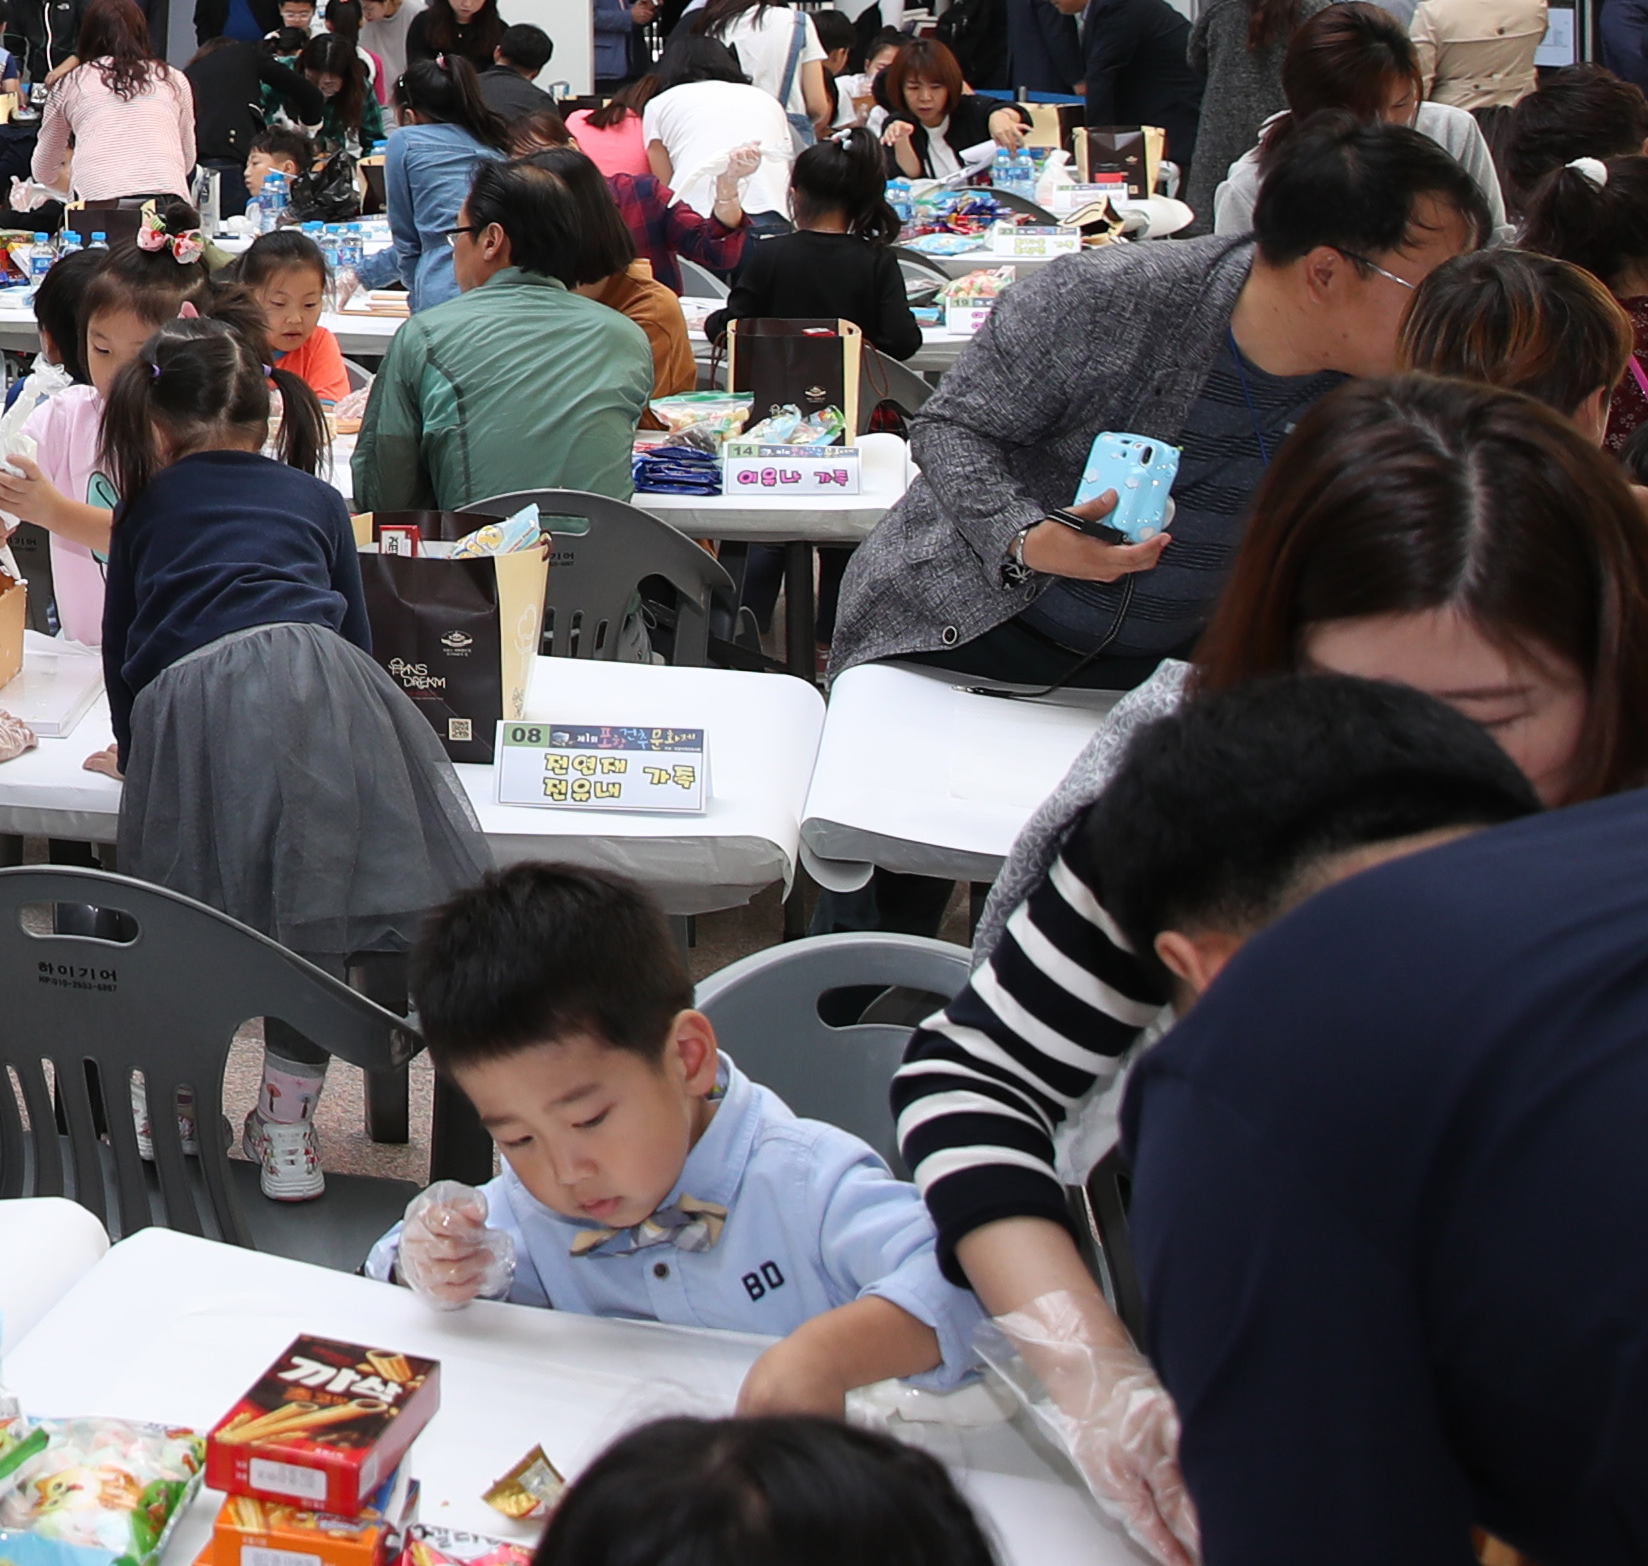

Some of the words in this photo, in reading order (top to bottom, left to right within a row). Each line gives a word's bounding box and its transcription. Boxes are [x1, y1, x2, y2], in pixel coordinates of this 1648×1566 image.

[732, 447, 753, 455] 14
[388, 657, 428, 677] HANS
[511, 727, 542, 744] 08
[576, 732, 598, 744] 제1회
[544, 752, 627, 776] 전연재
[643, 765, 696, 789] 가족
[38, 961, 117, 983] 하이기어
[741, 1260, 785, 1303] BD
